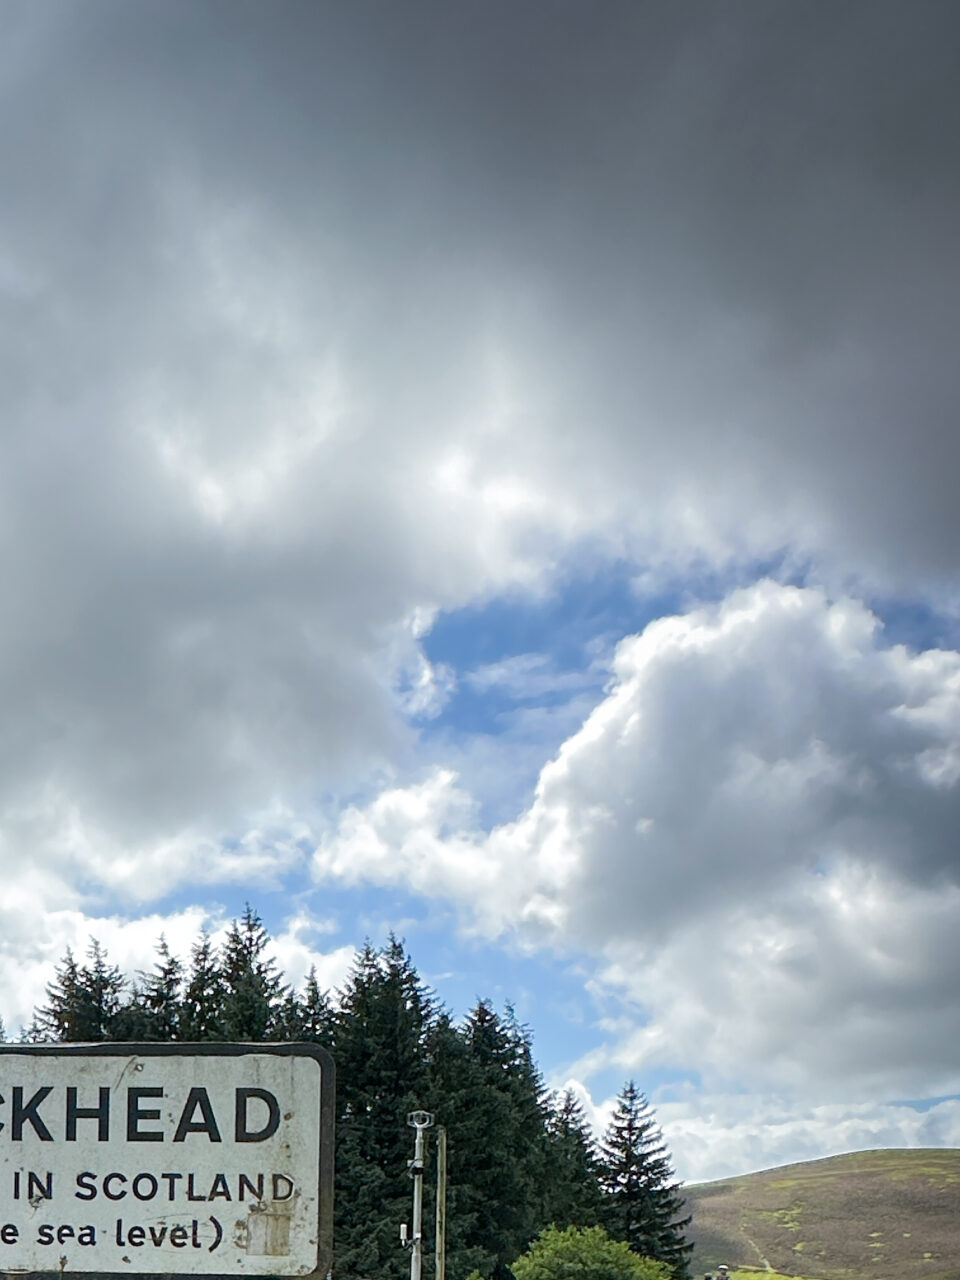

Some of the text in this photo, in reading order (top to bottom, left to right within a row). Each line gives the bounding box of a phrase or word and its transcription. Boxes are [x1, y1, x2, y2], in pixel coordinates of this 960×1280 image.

[14, 1171, 54, 1201] IN
[75, 1171, 295, 1202] SCOTLAND
[36, 1223, 96, 1246] sea
[116, 1215, 223, 1253] level)
